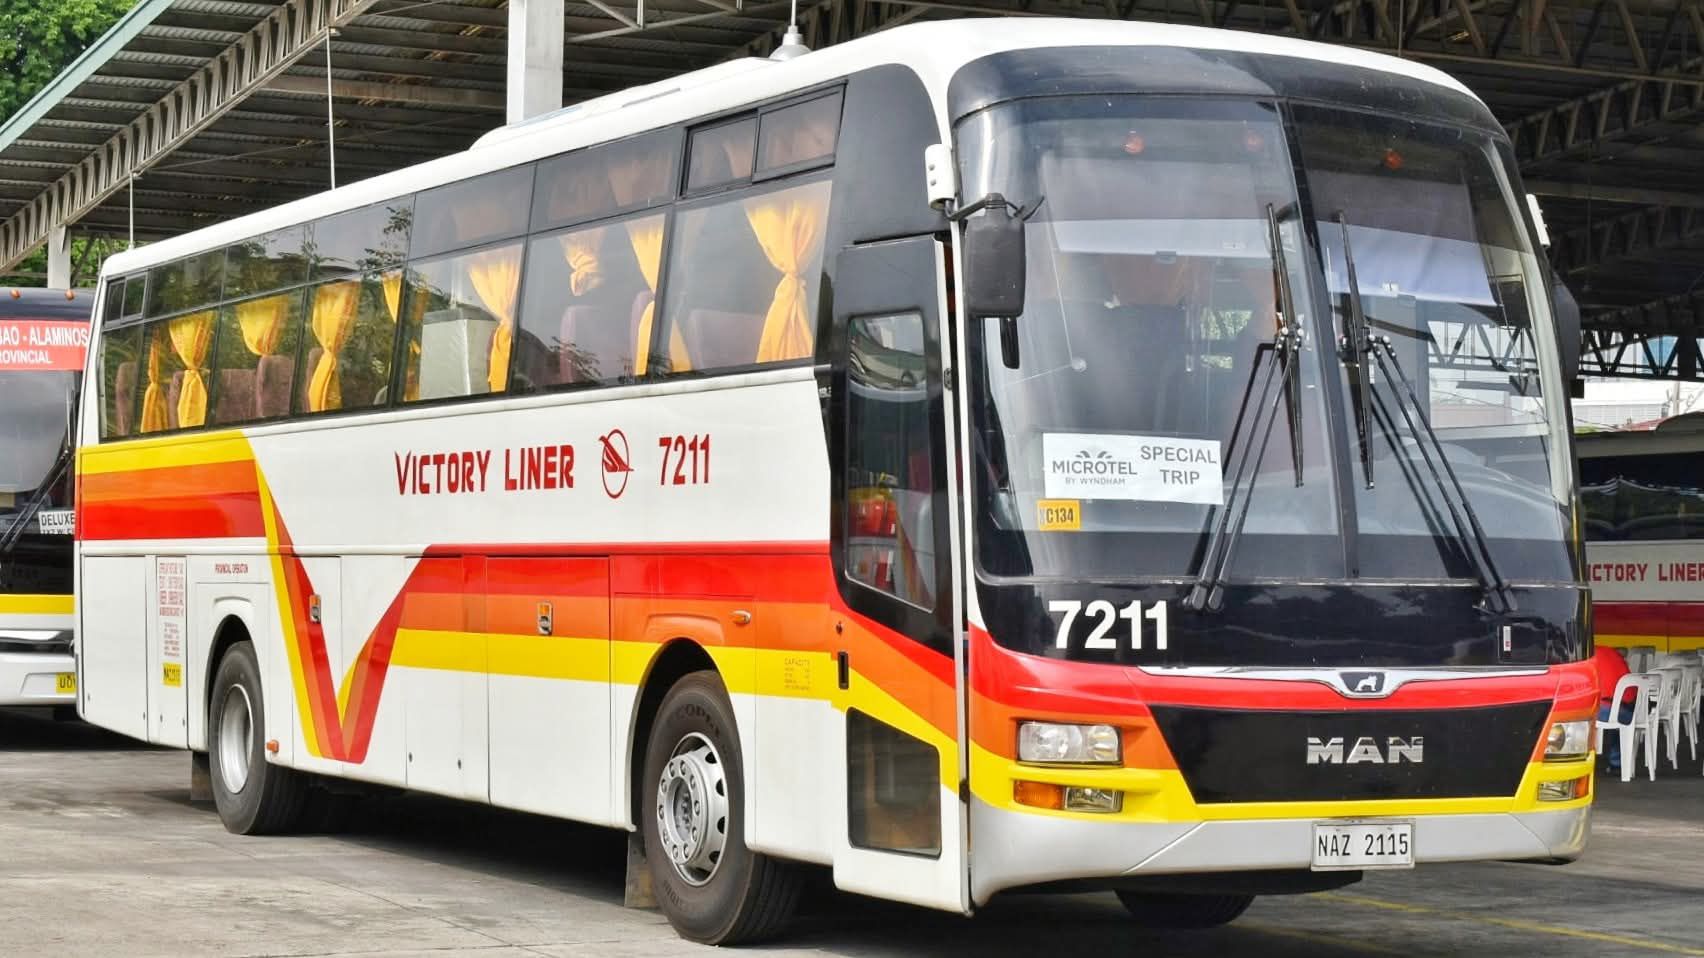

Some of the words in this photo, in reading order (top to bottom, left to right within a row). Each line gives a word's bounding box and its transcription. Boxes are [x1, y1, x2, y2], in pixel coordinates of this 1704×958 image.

[0, 326, 20, 347] AO
[30, 326, 89, 347] ALAMINOS
[0, 350, 54, 365] OVINCIAL
[1140, 445, 1217, 464] SPECIAL
[394, 450, 492, 495] VICTORY
[504, 445, 575, 491] LINER
[659, 434, 710, 486] 7211
[1052, 460, 1138, 476] MICROTEL
[1065, 477, 1076, 485] BY
[1079, 477, 1126, 486] WYNDHAM
[1159, 469, 1200, 485] TRIP
[41, 512, 75, 526] DELUXE
[1586, 563, 1649, 582] ICTORY
[1048, 599, 1168, 650] 7211
[1306, 736, 1424, 764] MAN
[1318, 834, 1351, 857] NAZ
[1364, 833, 1408, 856] 2115
